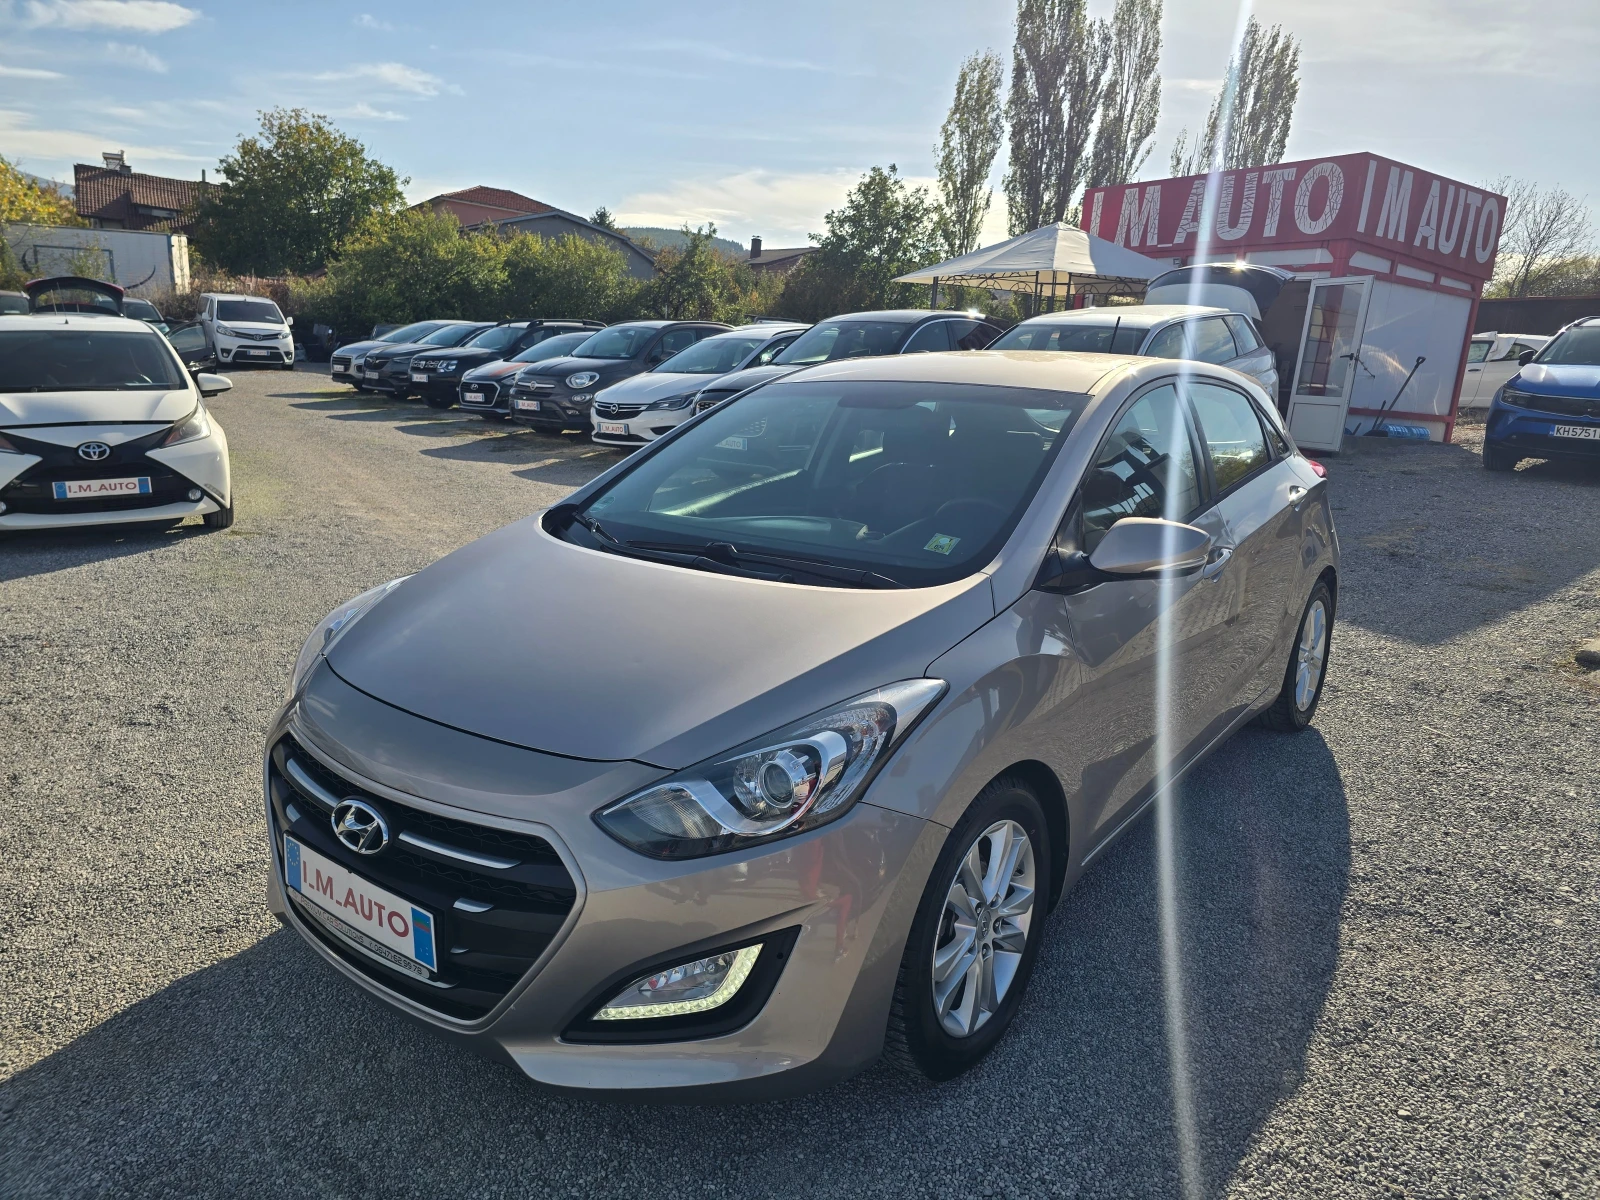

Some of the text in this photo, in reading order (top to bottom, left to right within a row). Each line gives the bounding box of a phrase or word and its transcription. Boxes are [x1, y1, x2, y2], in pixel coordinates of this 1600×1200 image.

[1413, 180, 1499, 263] AUTO
[68, 481, 137, 493] I_M_AUTO
[302, 860, 410, 937] I_M_AUTO
